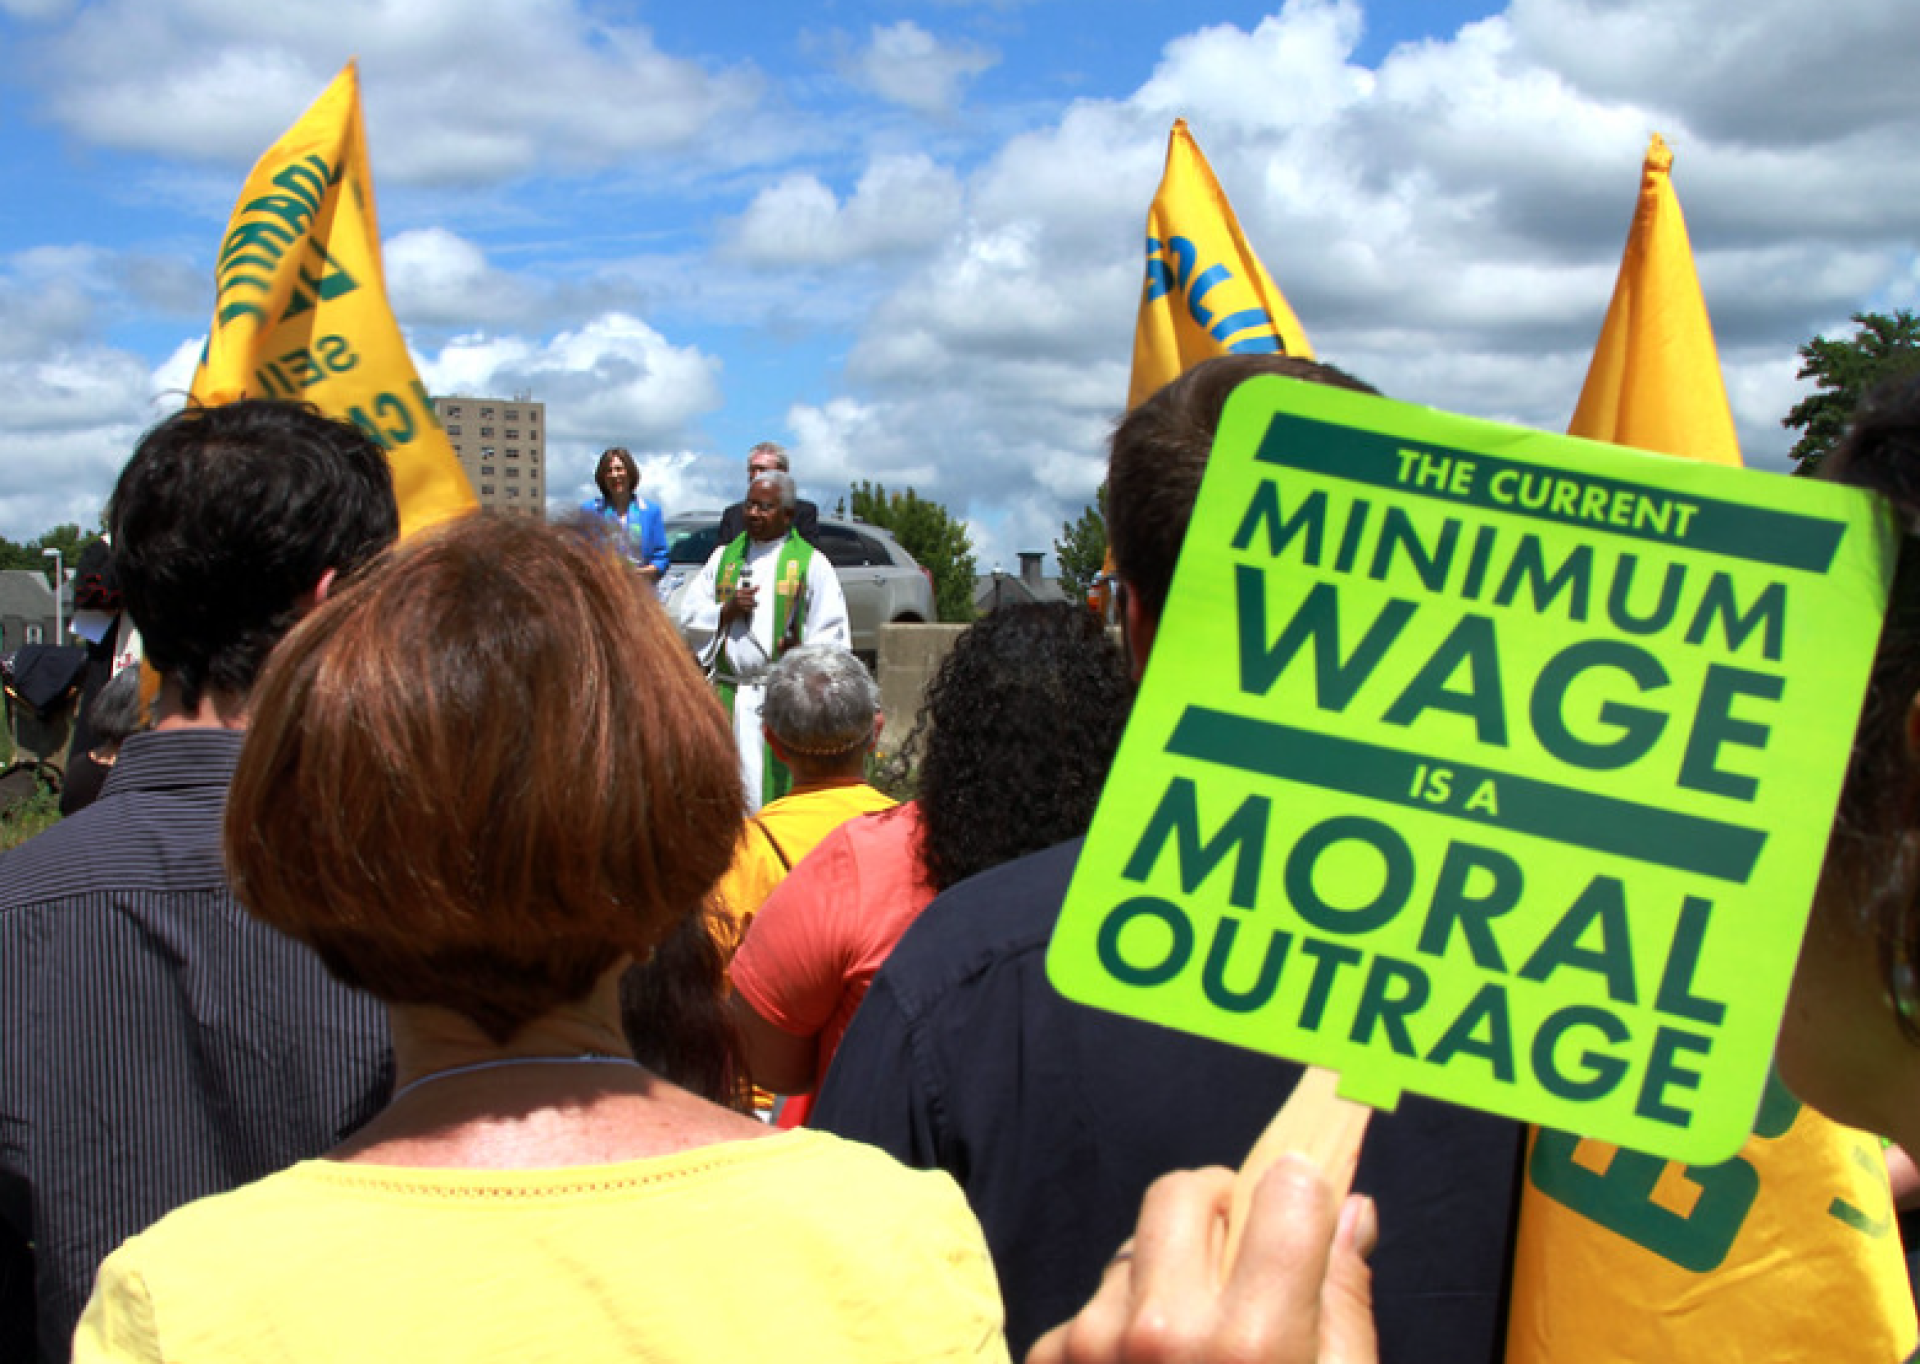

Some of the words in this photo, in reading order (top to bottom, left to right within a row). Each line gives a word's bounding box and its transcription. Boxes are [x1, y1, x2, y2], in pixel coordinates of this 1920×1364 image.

[1229, 477, 1788, 662] MINIMUM
[1395, 447, 1474, 494] THE
[1489, 467, 1699, 539] CURRENT
[1233, 563, 1788, 803] WAGE
[1409, 764, 1454, 803] IS
[1464, 779, 1499, 816] A
[1120, 776, 1729, 1027] MORAL
[1096, 896, 1714, 1129] OUTRAGE
